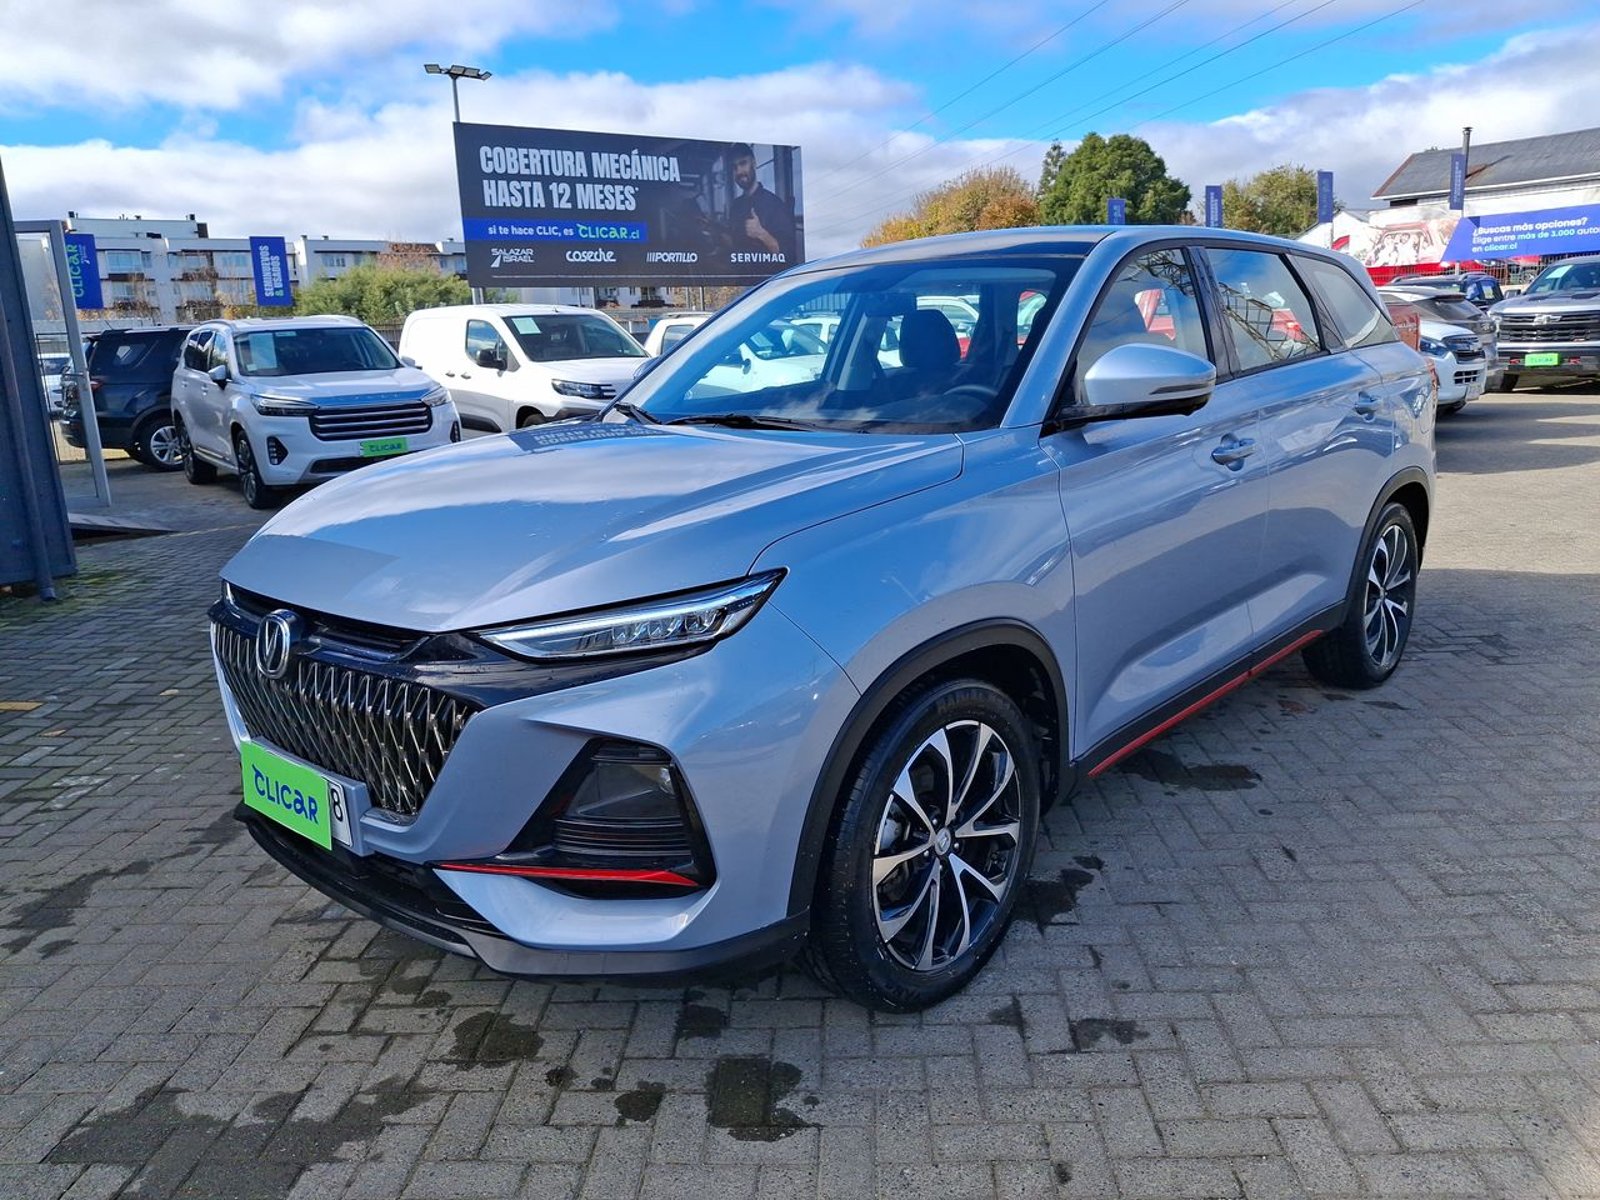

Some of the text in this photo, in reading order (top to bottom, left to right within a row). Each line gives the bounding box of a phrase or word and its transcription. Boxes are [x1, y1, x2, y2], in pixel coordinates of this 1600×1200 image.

[479, 145, 681, 182] COBERTURA MECÁNICA
[483, 179, 546, 208] HASTA
[549, 181, 572, 209] 12
[487, 224, 497, 235] si
[499, 225, 509, 235] te
[511, 225, 534, 236] hace
[536, 225, 561, 237] CLIC,
[563, 227, 574, 236] es
[1472, 235, 1492, 245] Elige
[1493, 233, 1516, 243] entre
[1517, 231, 1536, 240] más
[1538, 230, 1549, 239] de
[1577, 226, 1600, 236] auto
[1473, 217, 1588, 237] ¿Buscas más opciones?
[491, 248, 534, 256] SALAZAR
[1484, 242, 1517, 252] clicar.cl
[502, 255, 535, 263] ISRAEL
[730, 253, 786, 263] SERVIMAQ
[259, 244, 274, 297] SEMINUEVOS
[270, 255, 284, 297] & USADOS
